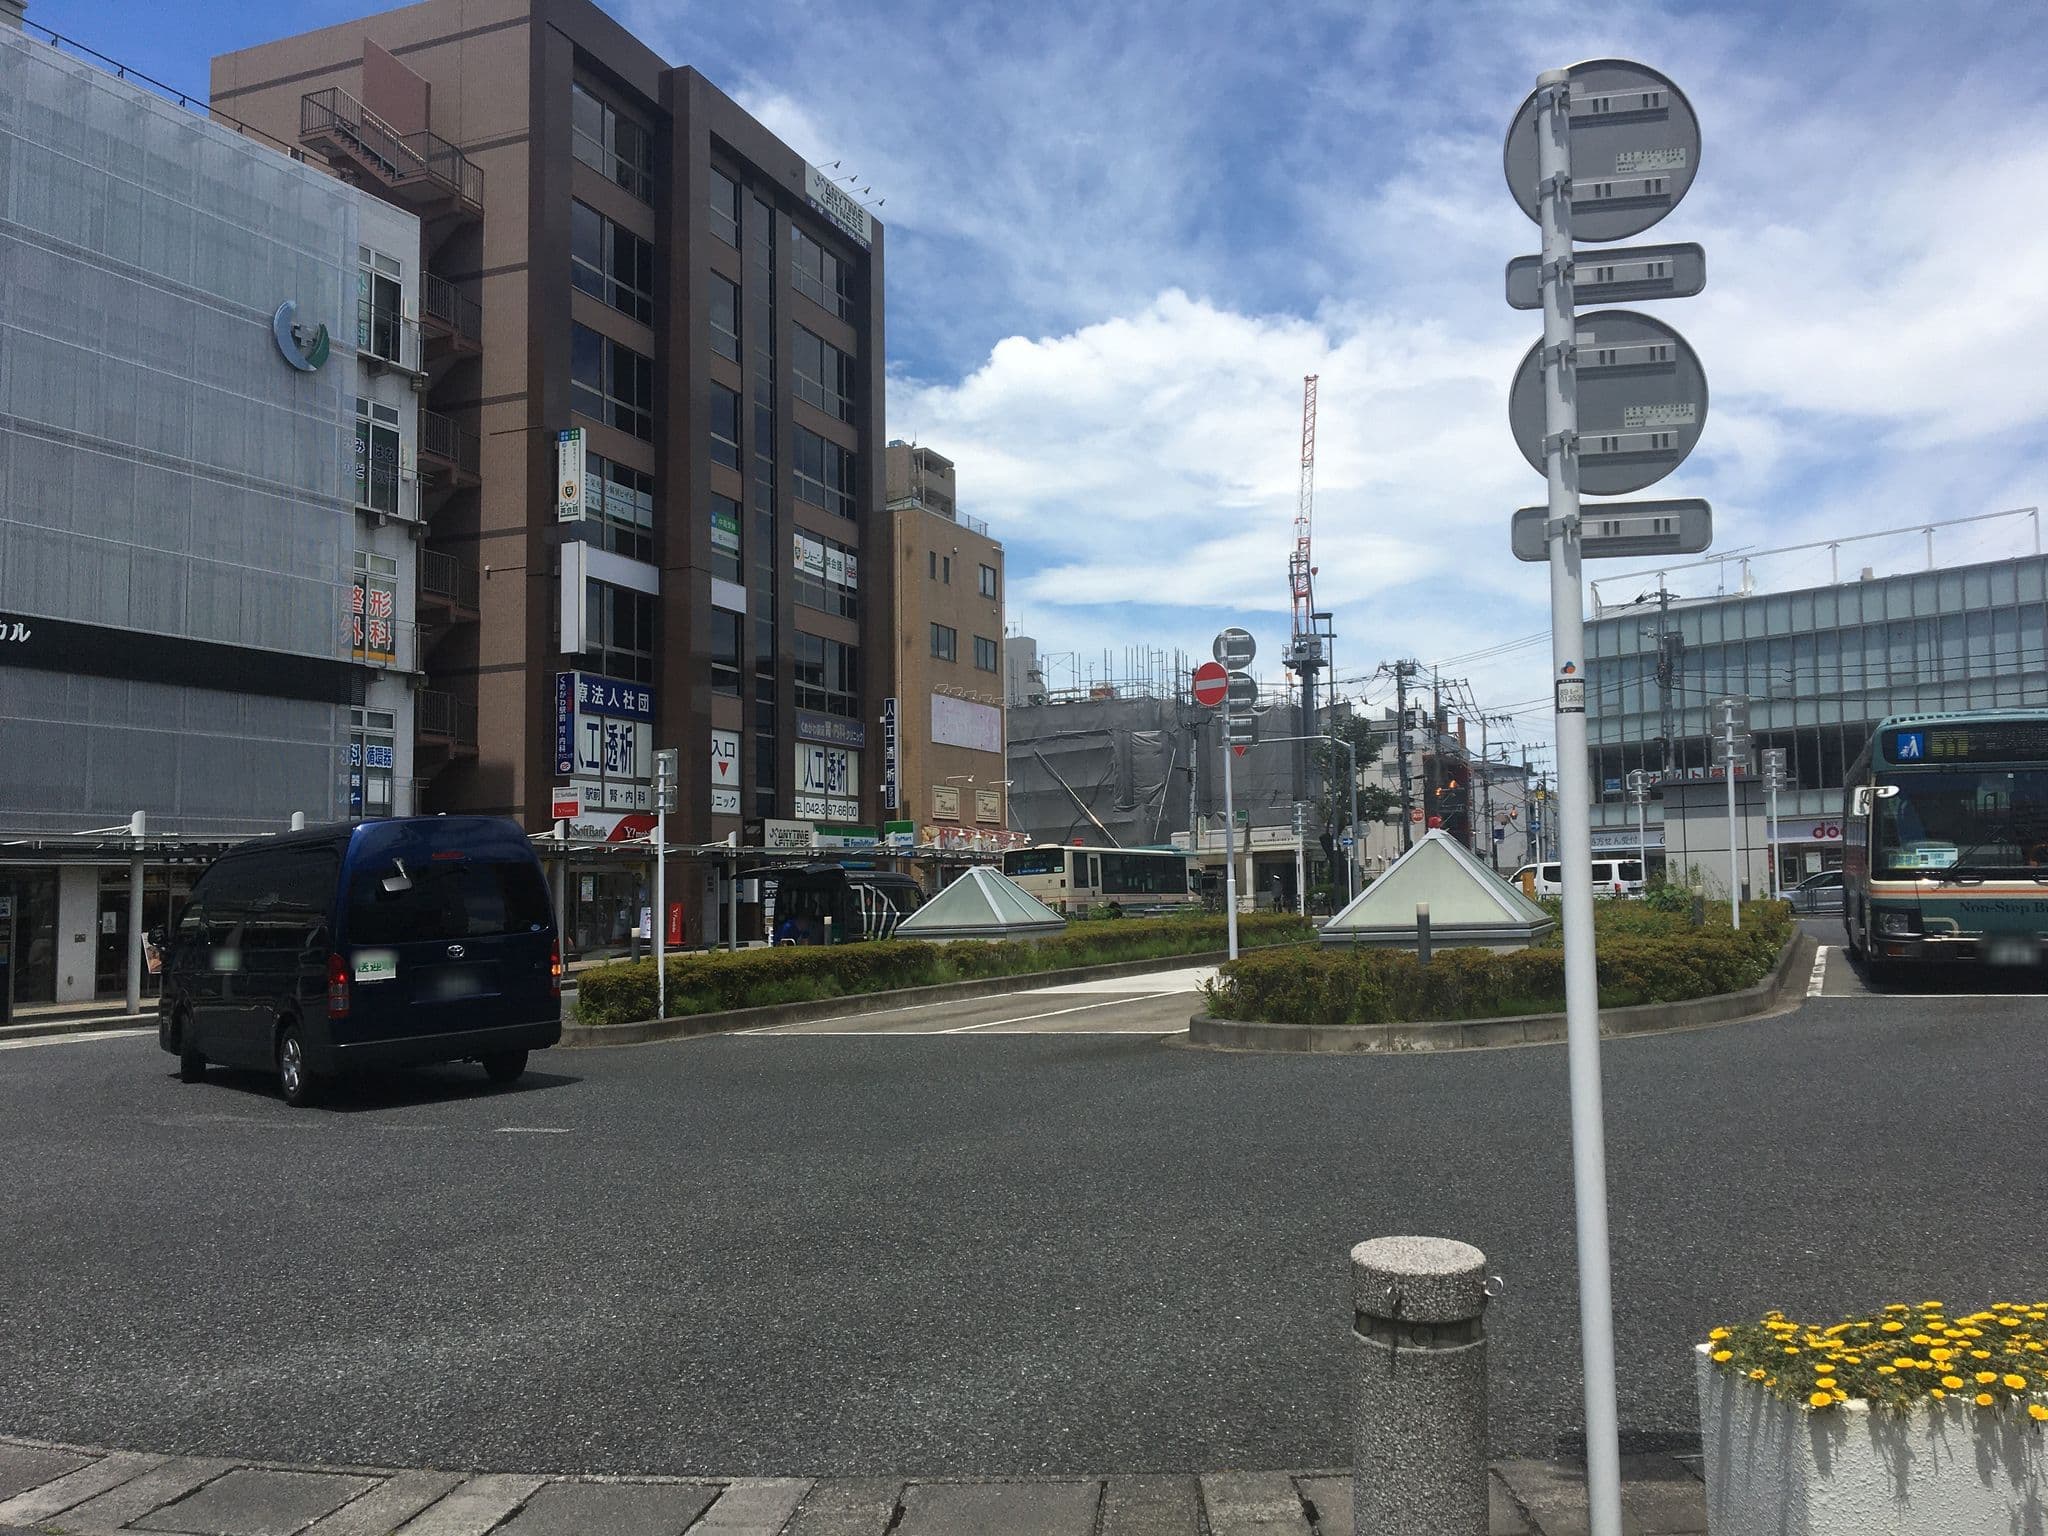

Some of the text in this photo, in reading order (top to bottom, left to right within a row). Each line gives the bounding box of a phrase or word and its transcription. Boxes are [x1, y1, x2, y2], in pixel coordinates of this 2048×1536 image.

[712, 740, 735, 758] 入口
[805, 749, 845, 793] 人工透析
[585, 787, 646, 804] 駅前 腎・内科
